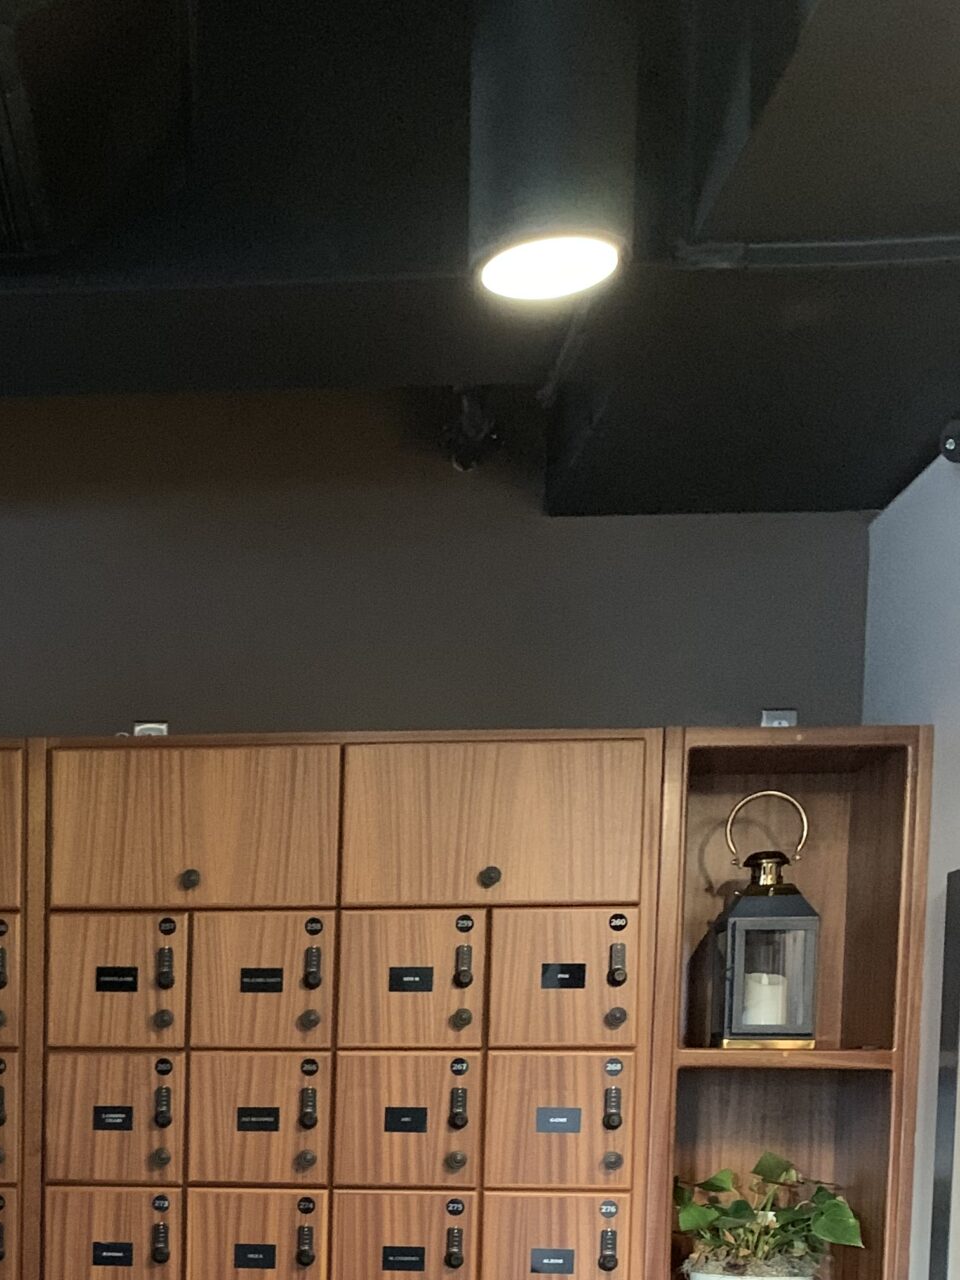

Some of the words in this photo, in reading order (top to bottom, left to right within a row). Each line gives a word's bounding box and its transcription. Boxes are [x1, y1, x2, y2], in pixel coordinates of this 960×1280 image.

[451, 1062, 467, 1071] 267
[448, 1203, 464, 1211] 275
[602, 1205, 618, 1213] 276
